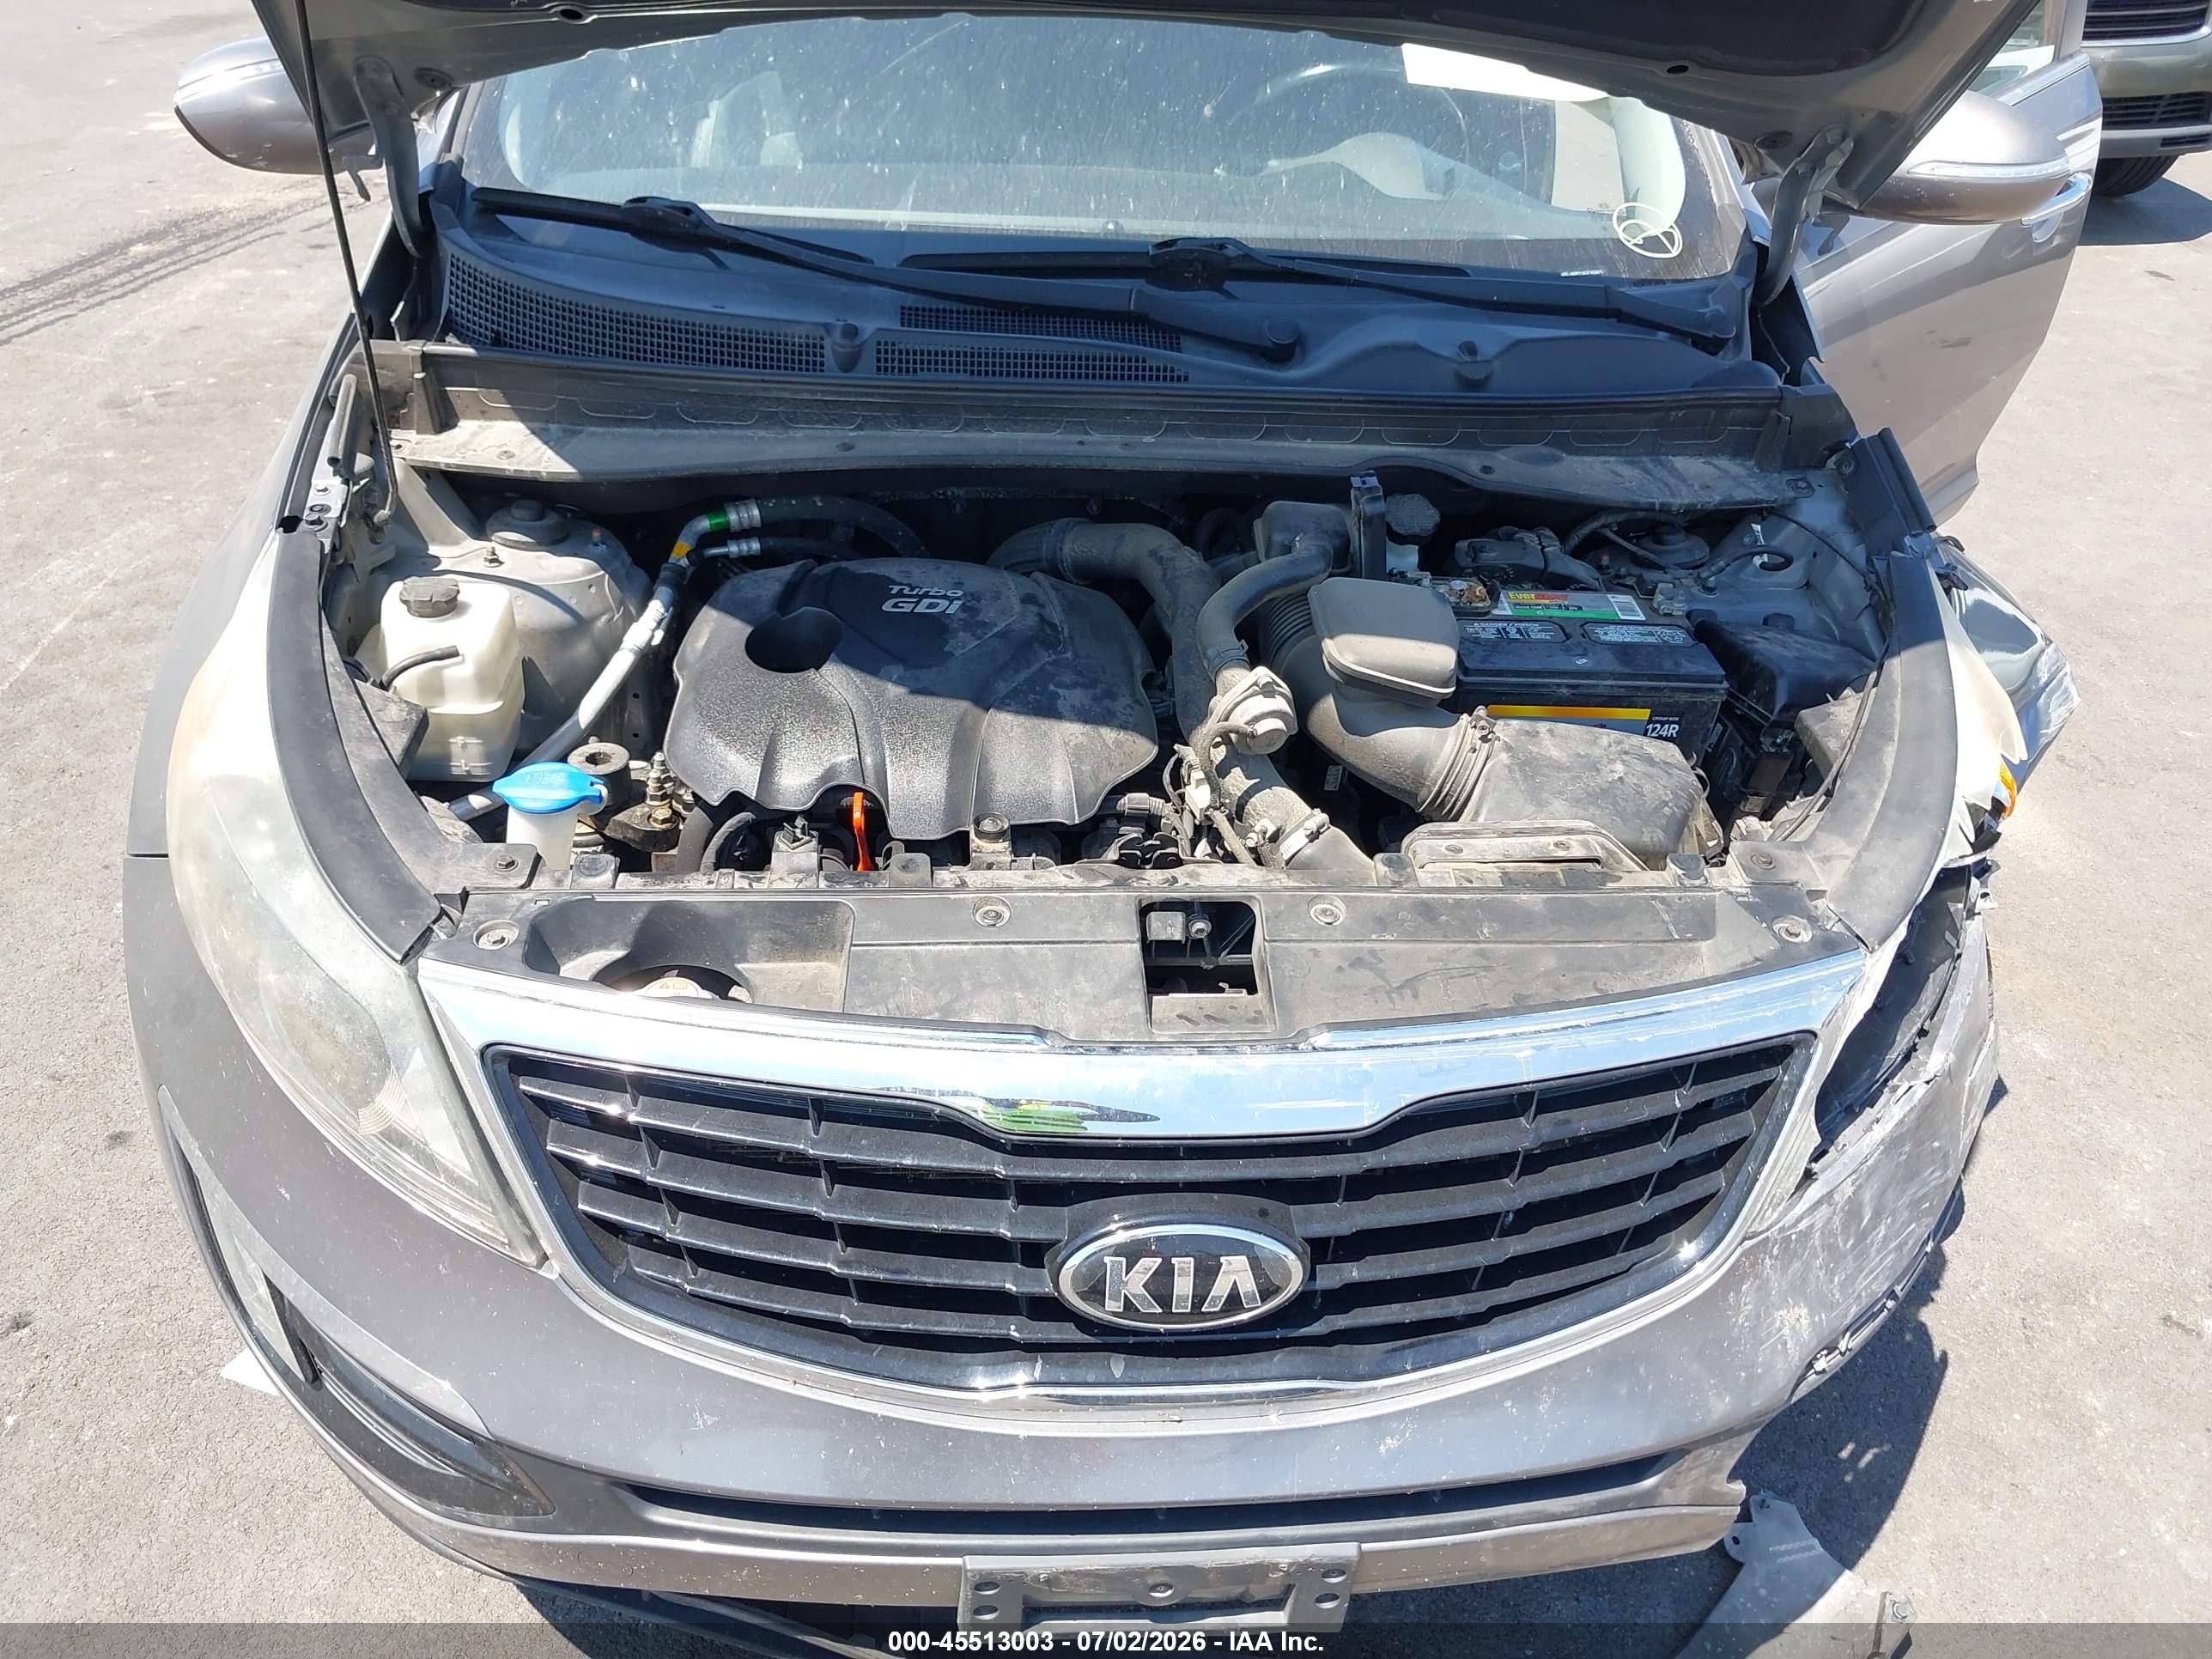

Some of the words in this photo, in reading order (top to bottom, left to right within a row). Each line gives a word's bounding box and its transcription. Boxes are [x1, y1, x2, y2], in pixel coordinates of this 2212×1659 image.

[888, 586, 964, 597] Turbo
[881, 599, 963, 614] GDi
[1646, 723, 1679, 738] 124R
[1103, 1255, 1261, 1313] KIA
